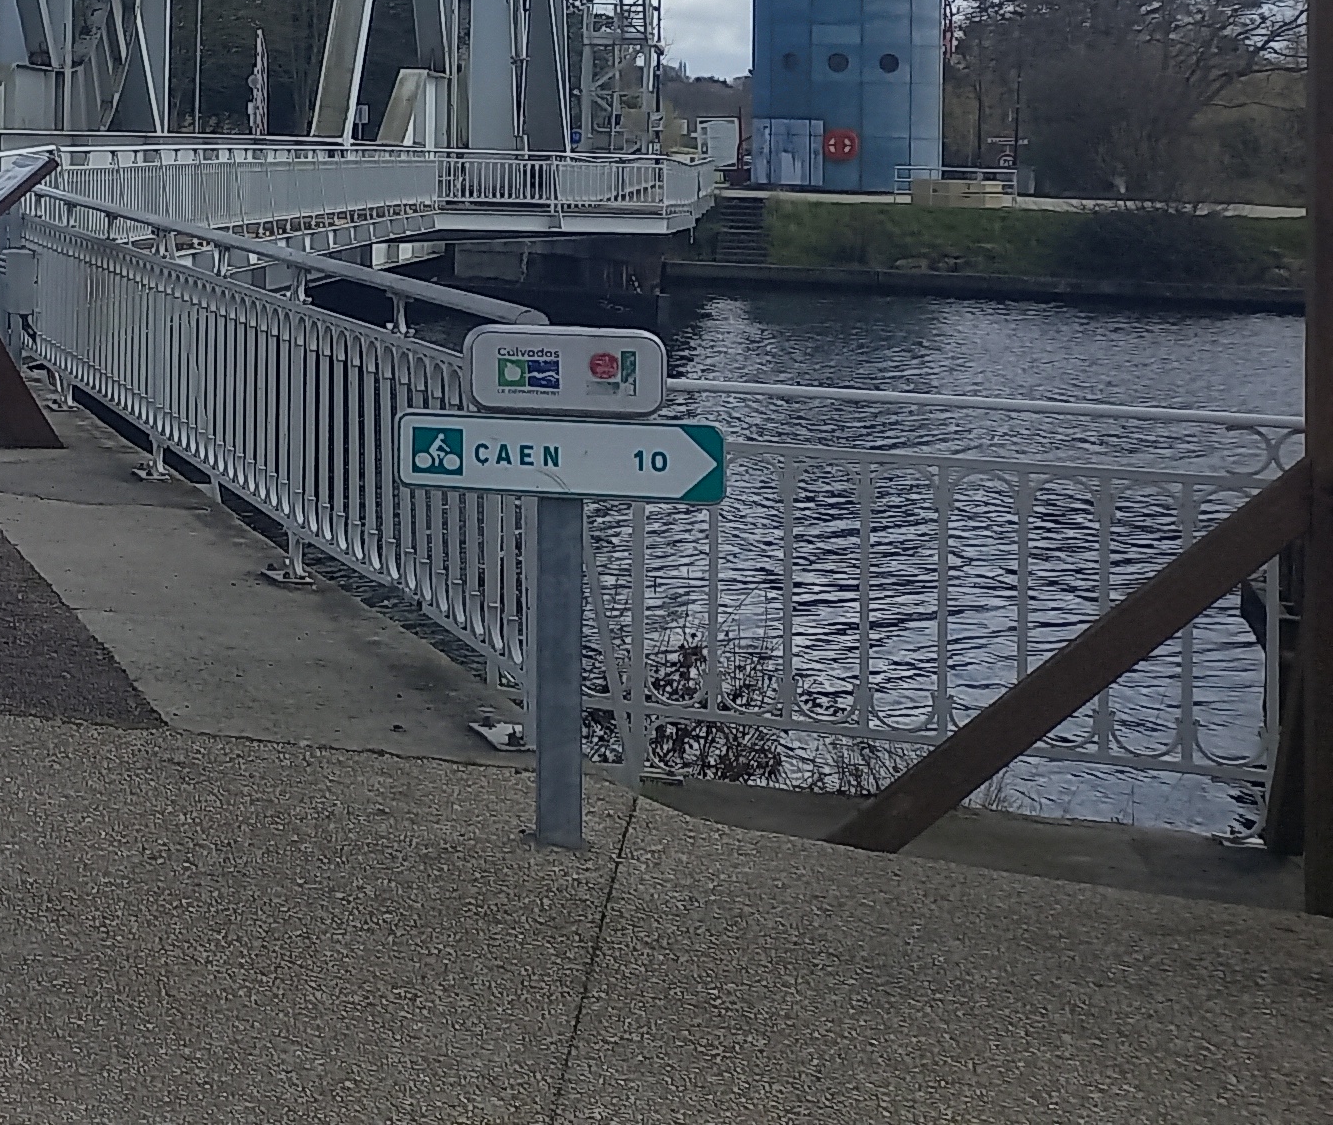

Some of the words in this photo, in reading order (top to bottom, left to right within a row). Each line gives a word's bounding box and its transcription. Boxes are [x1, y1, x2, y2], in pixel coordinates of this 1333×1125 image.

[497, 346, 560, 359] Calvados
[474, 442, 560, 467] CAEN
[633, 449, 668, 473] 10
